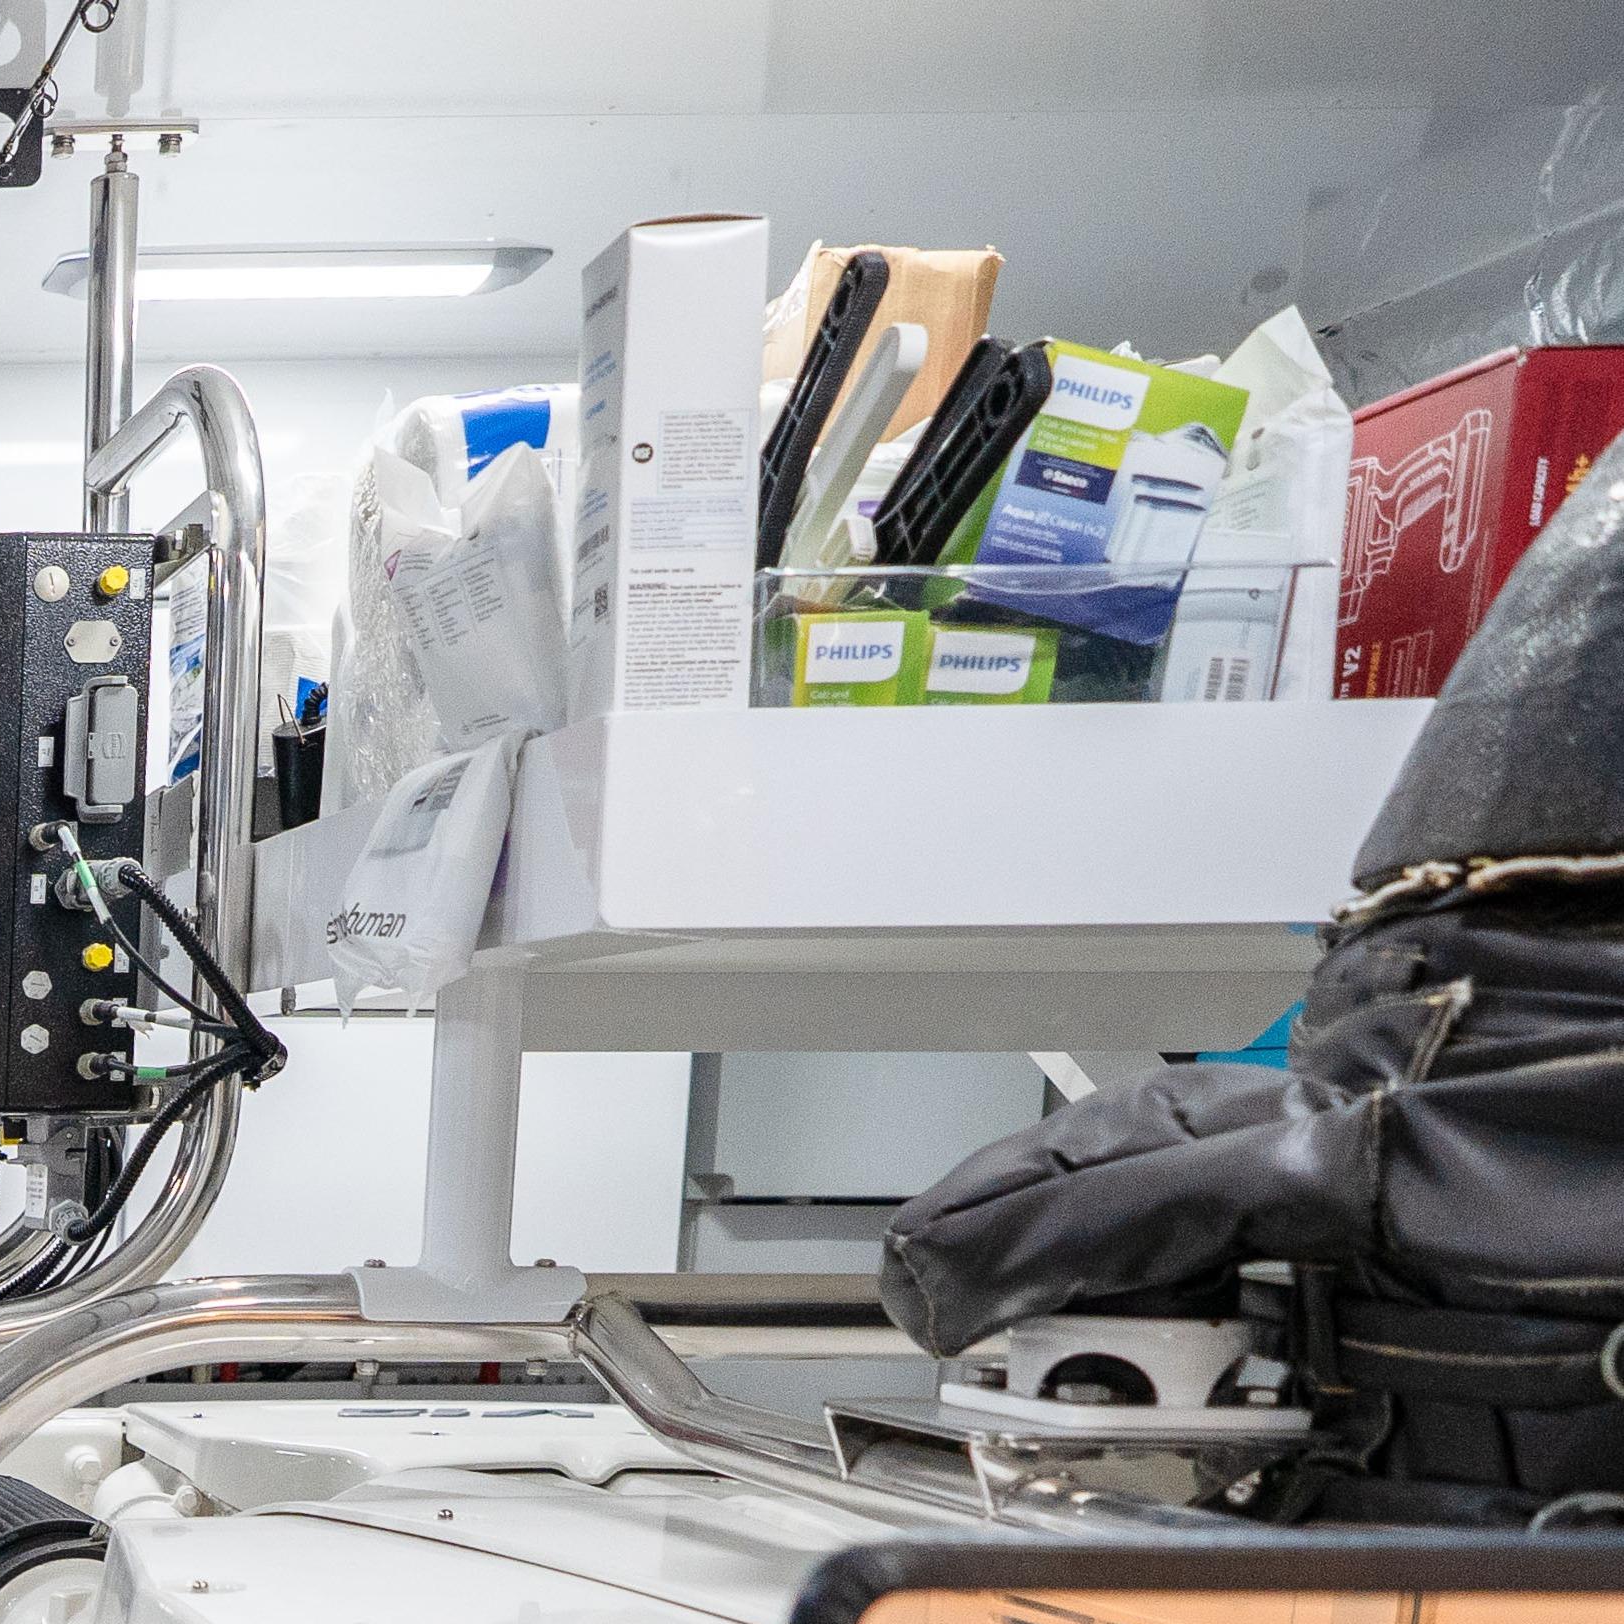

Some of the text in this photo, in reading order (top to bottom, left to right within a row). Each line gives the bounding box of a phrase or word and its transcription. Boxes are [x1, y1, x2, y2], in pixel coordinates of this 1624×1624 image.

[1054, 377, 1134, 411] PHILIPS
[815, 643, 893, 661] PHILIPS
[938, 653, 1022, 673] PHILIPS
[1342, 645, 1362, 678] V2
[326, 902, 407, 945] shuman
